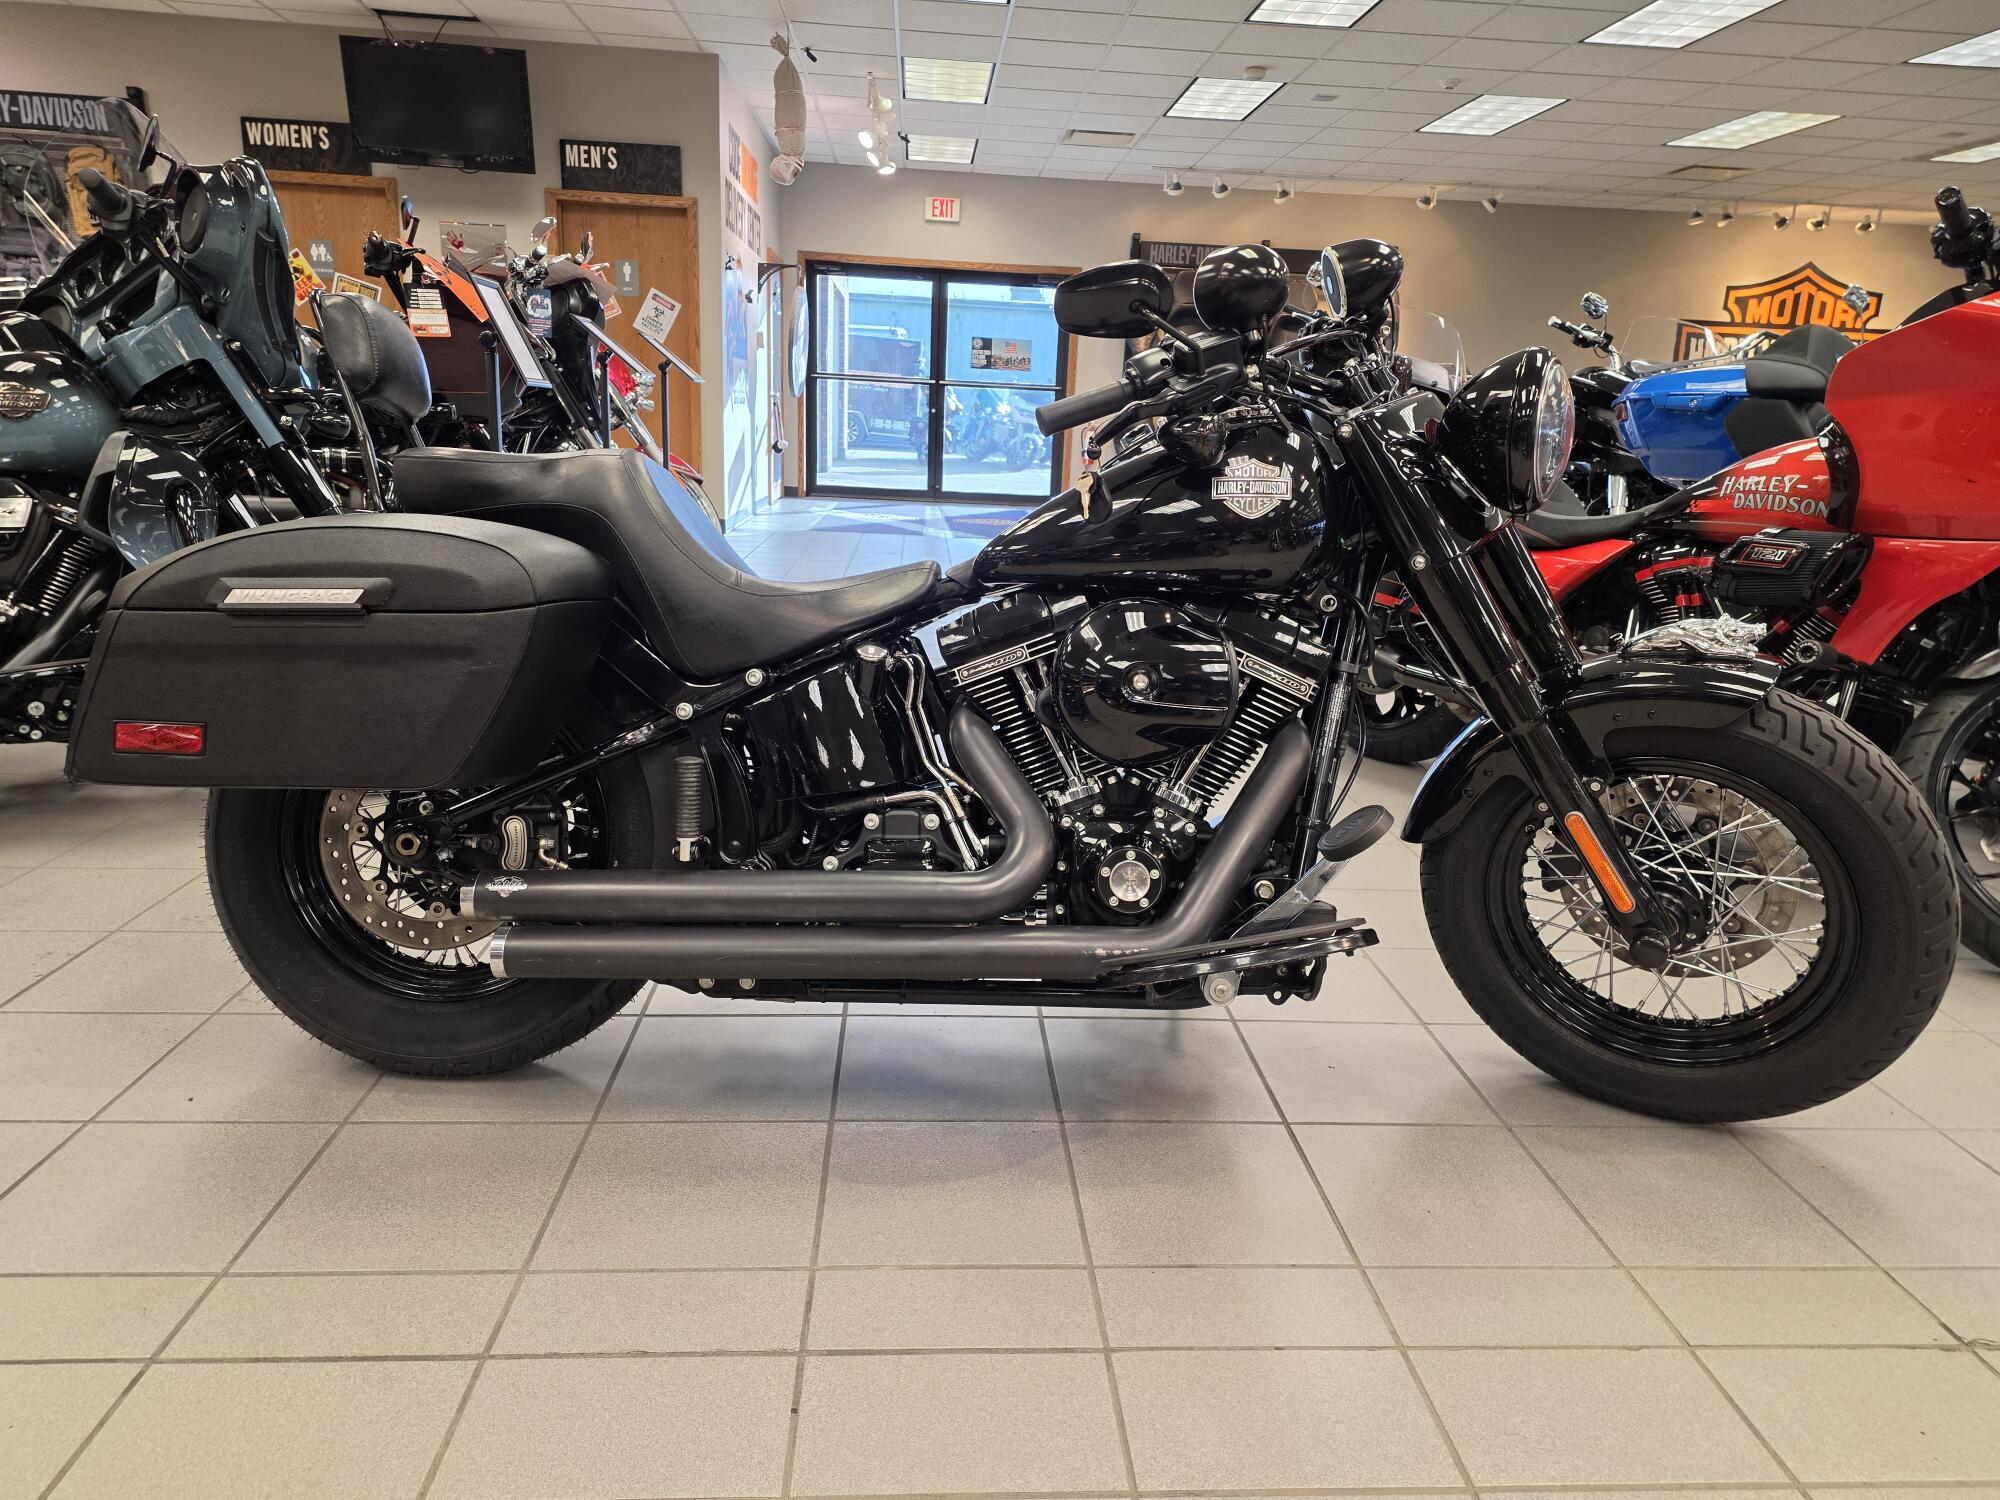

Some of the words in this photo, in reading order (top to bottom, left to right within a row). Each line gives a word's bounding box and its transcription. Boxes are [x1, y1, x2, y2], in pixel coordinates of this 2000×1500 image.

[0, 94, 109, 132] Y-DAVIDSON
[245, 121, 330, 150] WOMEN'S
[565, 144, 618, 170] MEN'S
[932, 198, 955, 218] EXIT
[1745, 281, 1858, 329] MOTOR
[646, 315, 663, 327] ZOMBIE
[1234, 464, 1272, 478] MOTOR
[1217, 481, 1287, 494] HARLEY-DAVIDSON
[1720, 475, 1809, 497] HARLEY-
[1232, 498, 1272, 513] CYCLES
[1733, 492, 1829, 519] DAVIDSON
[1751, 547, 1788, 561] 121
